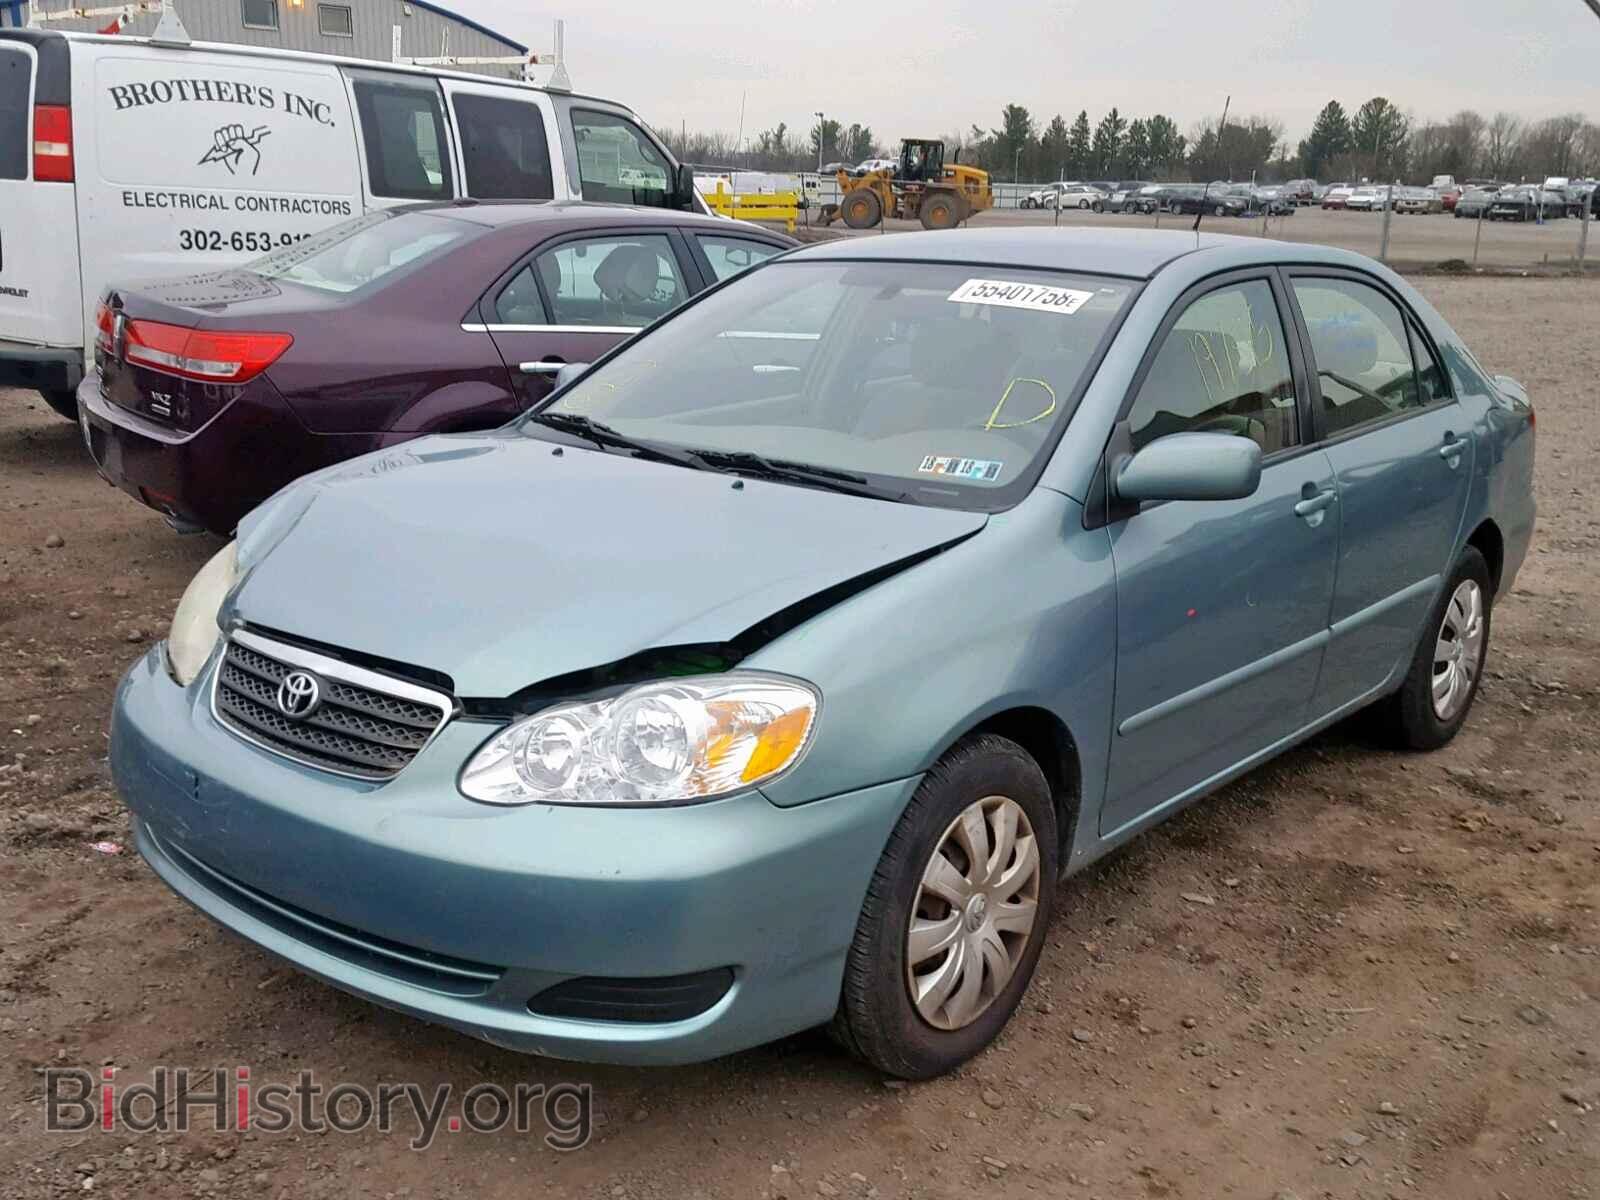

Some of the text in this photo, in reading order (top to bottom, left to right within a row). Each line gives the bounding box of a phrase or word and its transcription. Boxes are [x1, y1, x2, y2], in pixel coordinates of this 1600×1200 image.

[108, 79, 336, 127] BROTHER'S INC.
[122, 190, 352, 215] ELECTRICAL CONTRACTORS
[179, 229, 312, 252] 302-653-9
